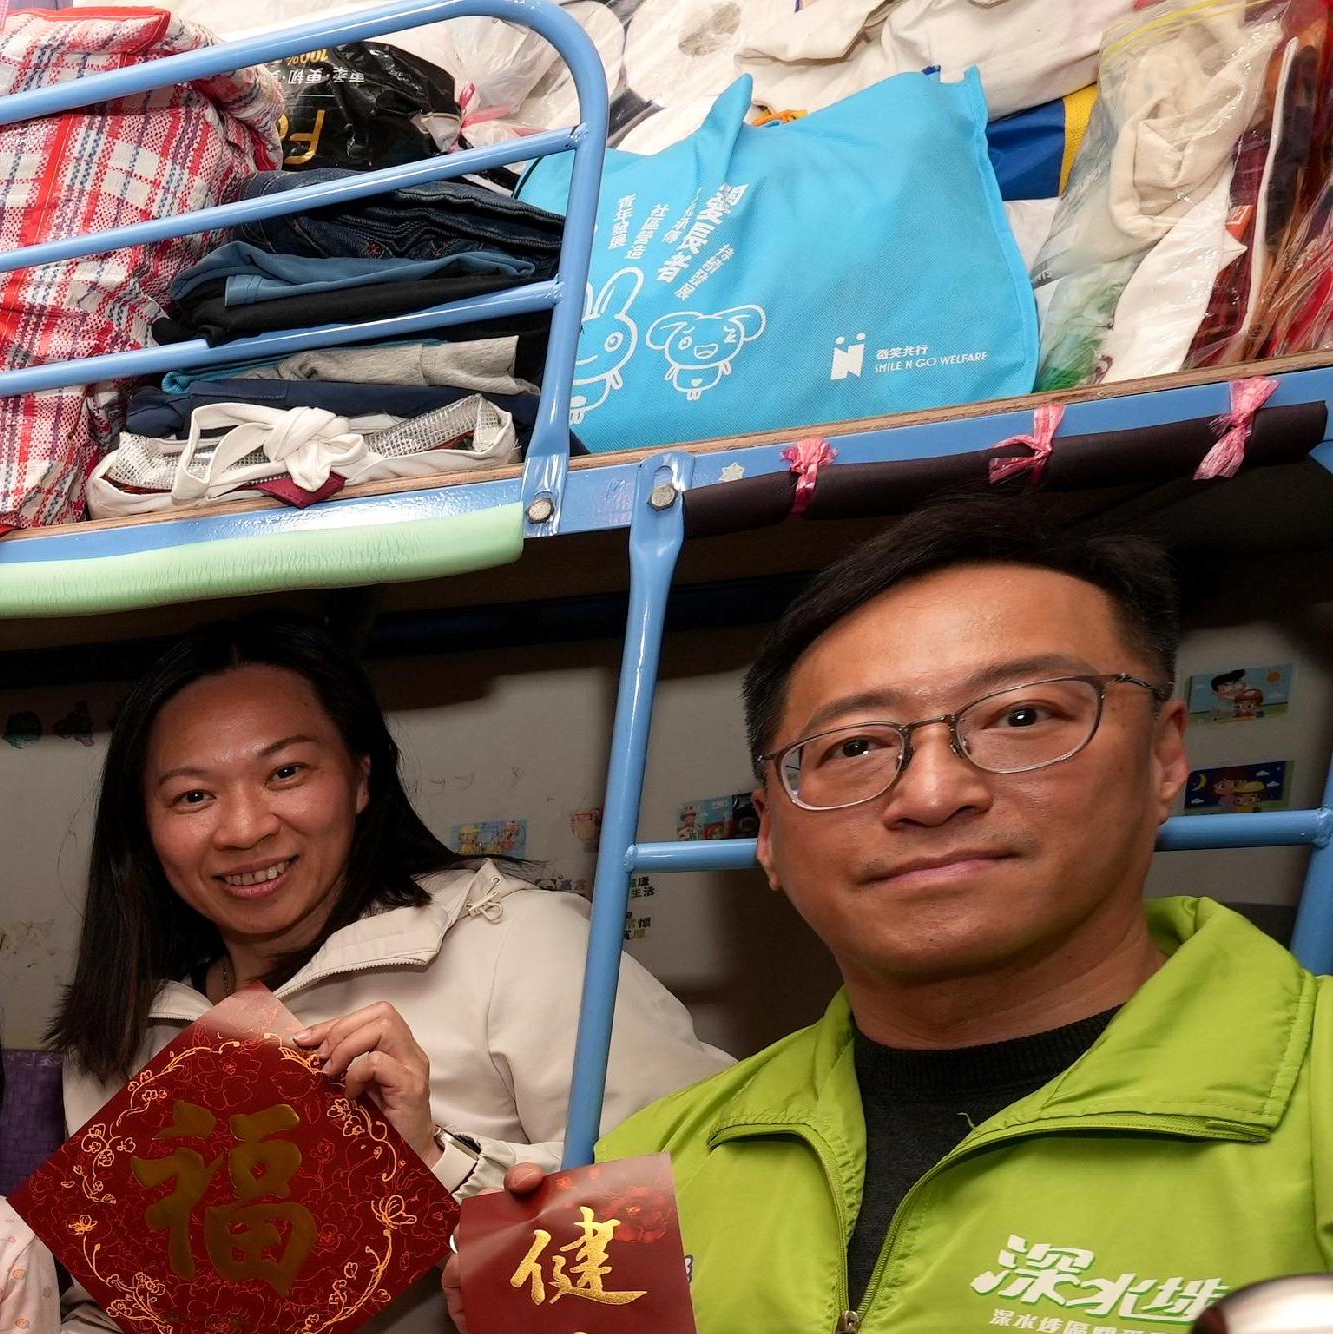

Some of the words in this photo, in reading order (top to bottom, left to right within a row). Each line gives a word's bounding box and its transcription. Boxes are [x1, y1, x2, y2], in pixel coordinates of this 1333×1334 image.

[916, 357, 937, 369] GO
[940, 352, 988, 366] WELFARE
[133, 1100, 318, 1297] 福
